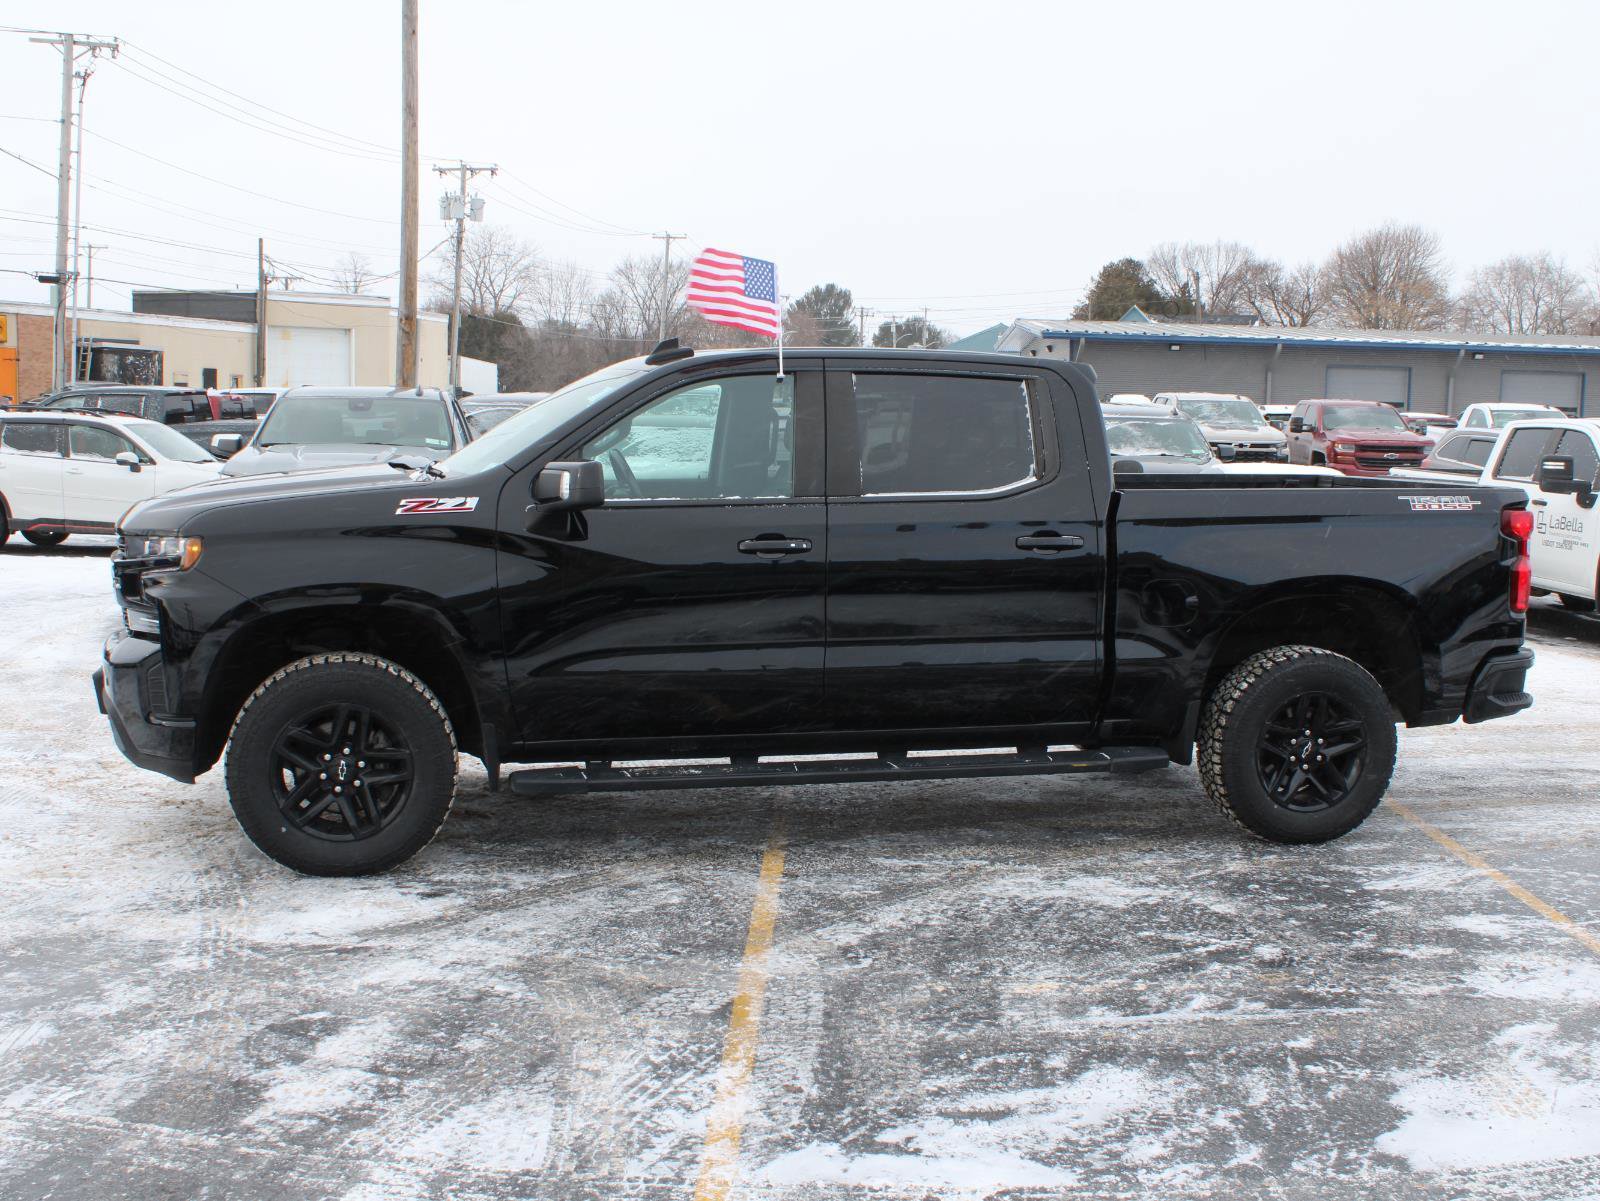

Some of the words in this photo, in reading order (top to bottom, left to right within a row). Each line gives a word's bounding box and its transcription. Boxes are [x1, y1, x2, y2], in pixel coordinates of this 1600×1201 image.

[395, 497, 479, 515] Z71
[1398, 496, 1481, 504] TRAIL
[1411, 503, 1473, 511] BOSS
[1549, 515, 1583, 533] LaBella
